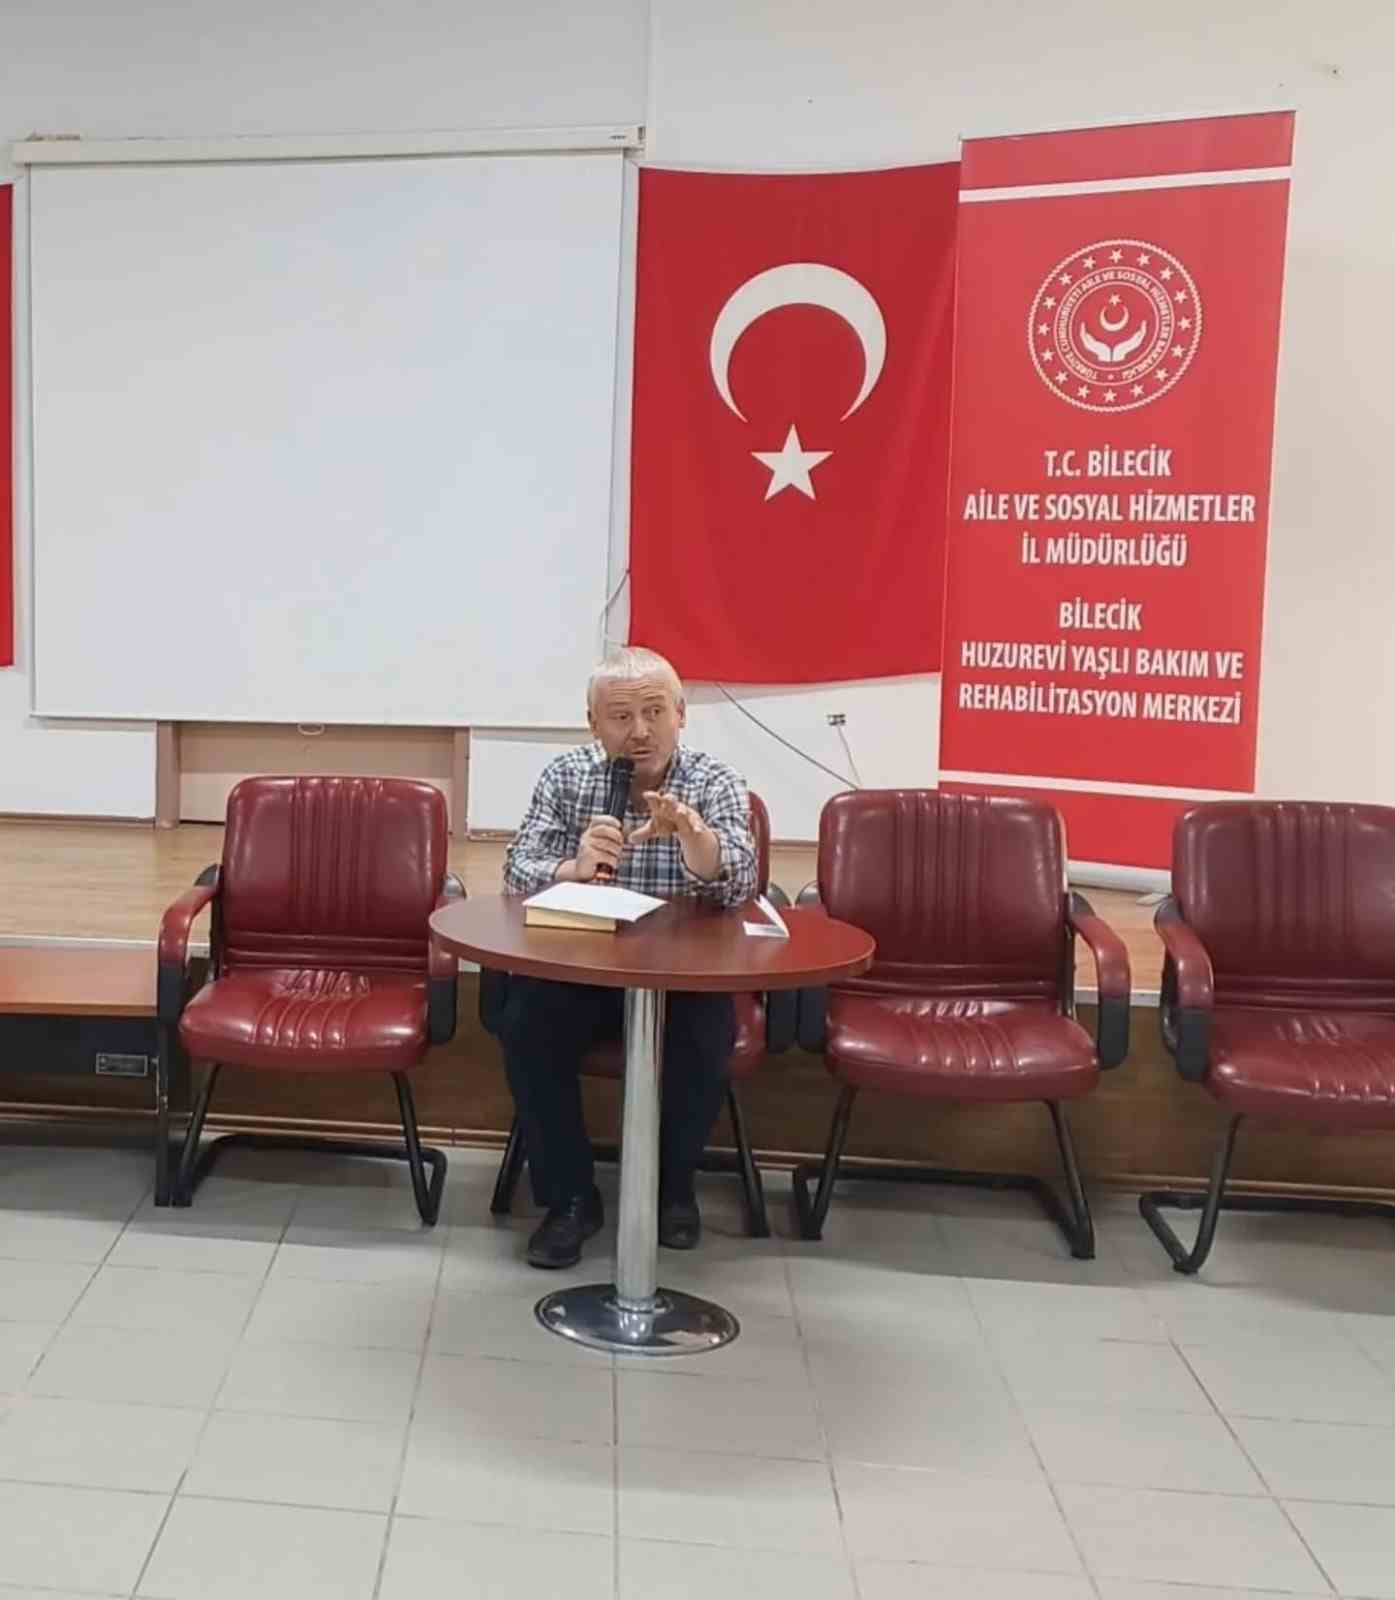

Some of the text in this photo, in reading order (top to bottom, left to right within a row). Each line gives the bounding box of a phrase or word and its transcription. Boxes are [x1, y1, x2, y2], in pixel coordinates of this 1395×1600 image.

[1045, 444, 1171, 476] T.C. BİLECİK
[964, 489, 1255, 522] AİLE VE SOSYAL HİZMETLER
[1022, 532, 1187, 566] İL MÜDÜRLÜĞÜ
[1060, 597, 1141, 630] BİLECİK
[962, 640, 1243, 679] HUZUREVİ YAŞLI BAKIM VE
[959, 681, 1240, 724] REHABİLİTASYON MERKEZİ
